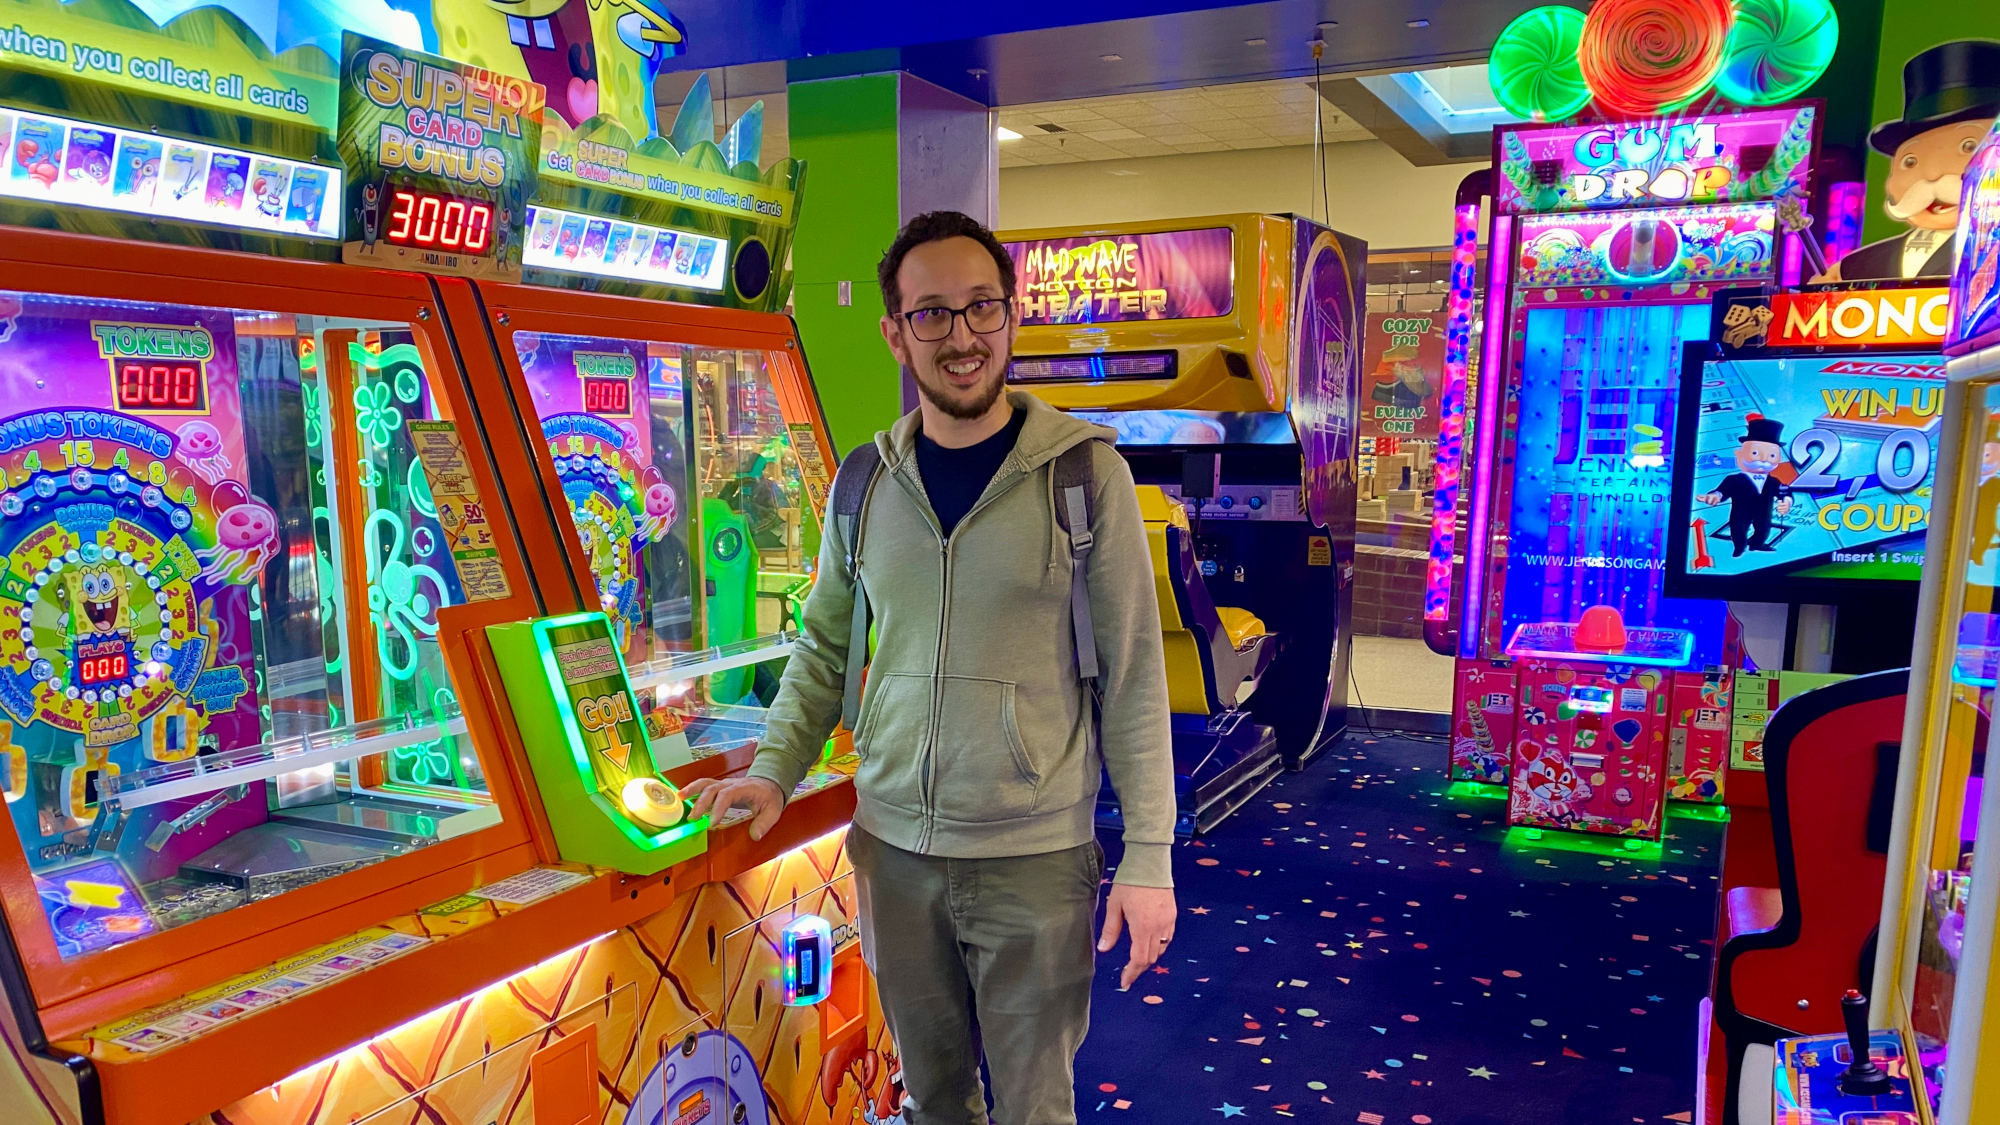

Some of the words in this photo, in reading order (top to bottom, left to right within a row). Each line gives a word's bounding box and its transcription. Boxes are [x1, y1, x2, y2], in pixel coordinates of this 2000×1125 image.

[73, 43, 122, 72] you
[129, 57, 210, 93] collect
[215, 75, 243, 100] all
[249, 86, 309, 114] cards
[366, 53, 521, 137] SUPER
[407, 108, 483, 147] CARD
[380, 124, 505, 187] BONUS
[577, 139, 629, 170] SUPER
[1574, 123, 1720, 167] GUM
[547, 150, 573, 173] Get
[575, 160, 610, 183] CARD
[647, 176, 680, 195] when
[680, 183, 702, 200] you
[1572, 166, 1732, 201] DROP
[704, 188, 739, 207] collect
[741, 195, 753, 211] all
[755, 200, 783, 217] cards
[388, 192, 490, 249] 3000
[419, 252, 459, 268] ANDAMIRO
[1026, 245, 1071, 280] MAD
[1078, 243, 1139, 279] WAVE
[1026, 277, 1138, 293] MOTION
[1021, 289, 1168, 320] HEATER
[1382, 318, 1432, 334] COZY
[96, 325, 210, 358] TOKENS
[1392, 335, 1420, 347] FOR
[575, 354, 634, 378] TOKENS
[121, 366, 196, 403] 000
[587, 382, 627, 410] 000
[1821, 387, 1899, 418] WIN
[1374, 405, 1426, 419] EVERY
[64, 411, 174, 460] TOKENS
[570, 415, 624, 449] TOKENS
[1383, 420, 1415, 433] ONE
[550, 441, 559, 458] 4
[567, 435, 585, 455] 15
[593, 441, 602, 457] 4
[610, 450, 620, 469] 8
[627, 469, 636, 485] 4
[23, 450, 41, 473] 4
[59, 440, 94, 467] 15
[113, 448, 130, 469] 4
[148, 461, 168, 486] 8
[181, 486, 197, 506] 4
[437, 474, 465, 484] SUPER
[54, 503, 115, 526] BONUS
[464, 504, 482, 519] 50
[1818, 503, 1931, 532] COUP
[15, 525, 57, 557] TOKENS
[116, 520, 156, 546] TOKENS
[22, 561, 37, 577] 2
[39, 545, 53, 560] 3
[59, 535, 72, 550] 2
[106, 531, 117, 546] 2
[126, 538, 137, 552] 3
[142, 550, 155, 565] 2
[171, 536, 201, 577] BONUS
[1832, 551, 1875, 563] Insert
[1880, 552, 1888, 563] 1
[160, 564, 174, 581] 2
[166, 544, 193, 582] PLAYS
[6, 579, 25, 596] 2
[166, 587, 179, 599] 2
[3, 605, 19, 618] 2
[172, 608, 185, 619] 3
[183, 589, 196, 633] TOKENS
[2, 628, 18, 641] 3
[172, 629, 184, 640] 2
[9, 650, 24, 665] 2
[78, 640, 126, 657] PLAYS
[558, 650, 577, 665] Push
[576, 648, 590, 661] the
[588, 645, 613, 659] button
[82, 656, 126, 681] 000
[563, 668, 573, 680] to
[571, 662, 597, 678] launch
[594, 659, 618, 673] Token
[41, 689, 55, 703] 2
[141, 687, 154, 699] 3
[193, 680, 246, 701] TOKENS
[1488, 693, 1510, 707] JET
[60, 700, 73, 714] 3
[82, 704, 94, 719] 2
[125, 696, 136, 710] 2
[137, 687, 173, 716] TOKENS
[205, 695, 234, 712] OUT
[577, 690, 633, 732] GO!!
[41, 709, 84, 732] TOKENS
[89, 713, 132, 731] CARD
[1696, 709, 1720, 722] JET
[89, 724, 136, 746] DROP
